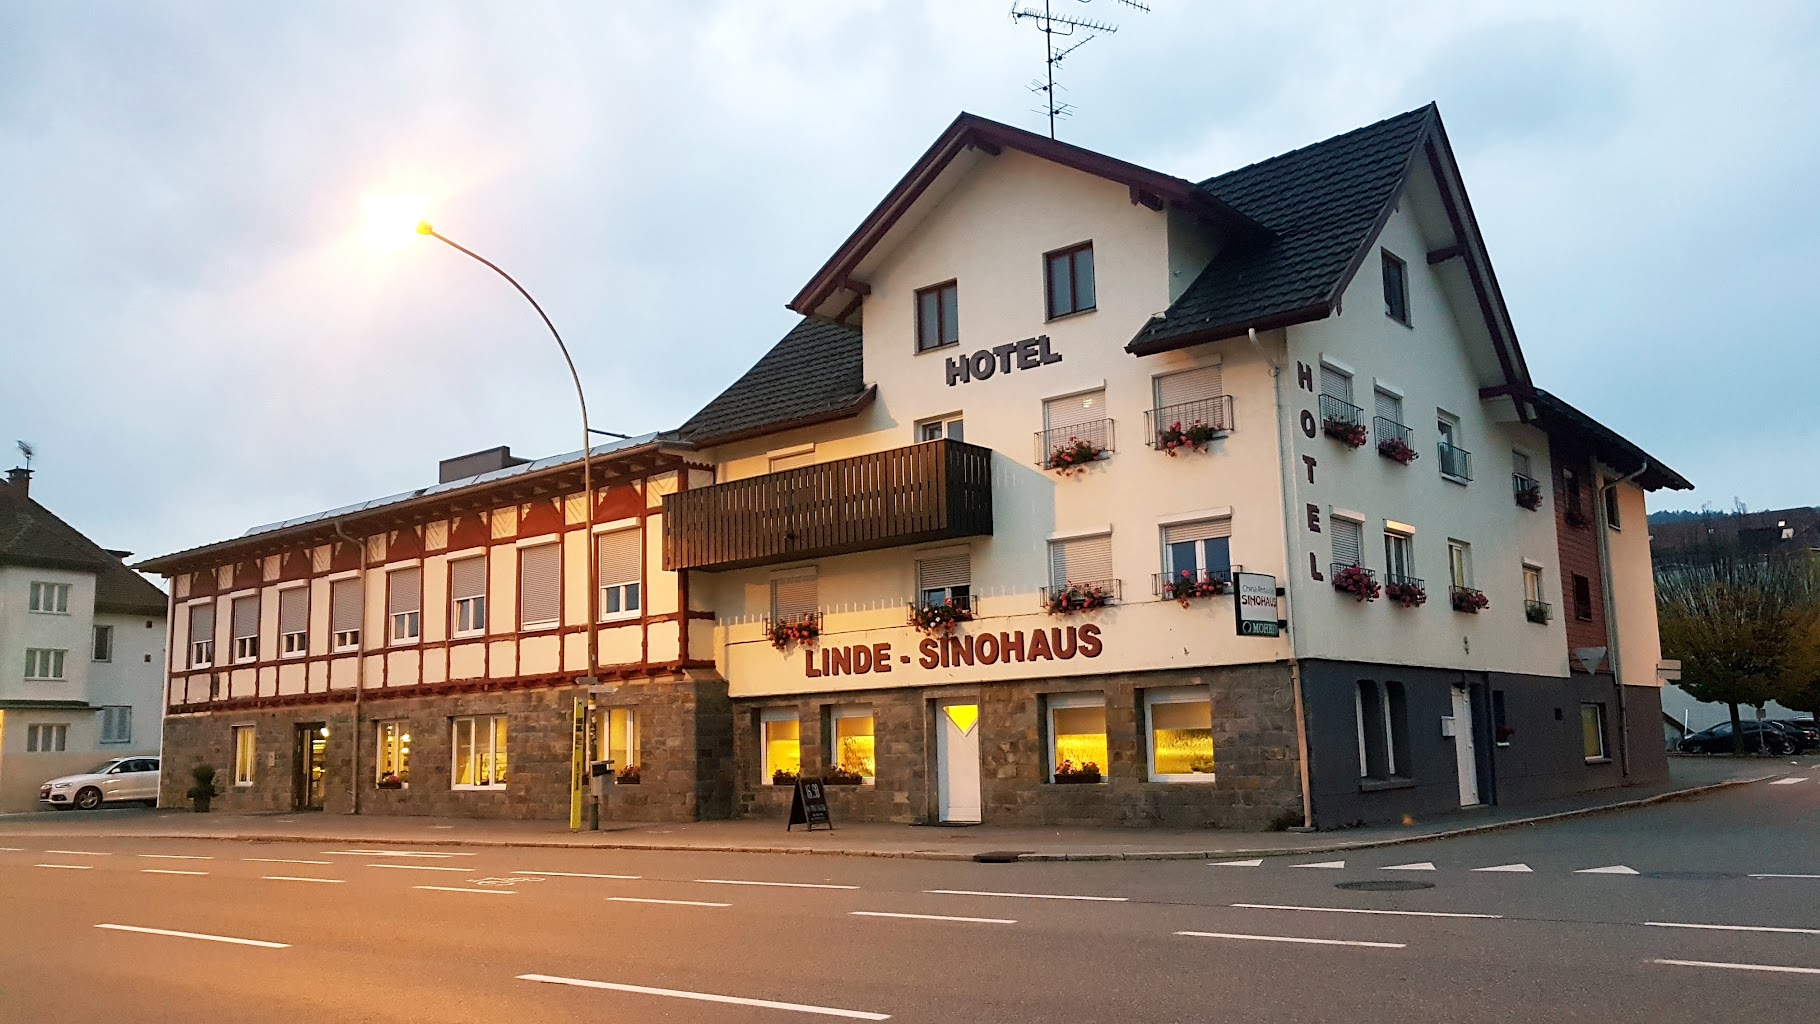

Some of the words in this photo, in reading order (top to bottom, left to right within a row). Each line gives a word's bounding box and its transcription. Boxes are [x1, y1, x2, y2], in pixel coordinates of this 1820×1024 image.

[945, 334, 1062, 387] HOTEL
[1297, 360, 1324, 582] HOTEL
[1242, 594, 1277, 607] SINOHAUS
[805, 642, 892, 678] LINDE
[899, 654, 911, 664] -
[918, 623, 1103, 668] SINOHAUS
